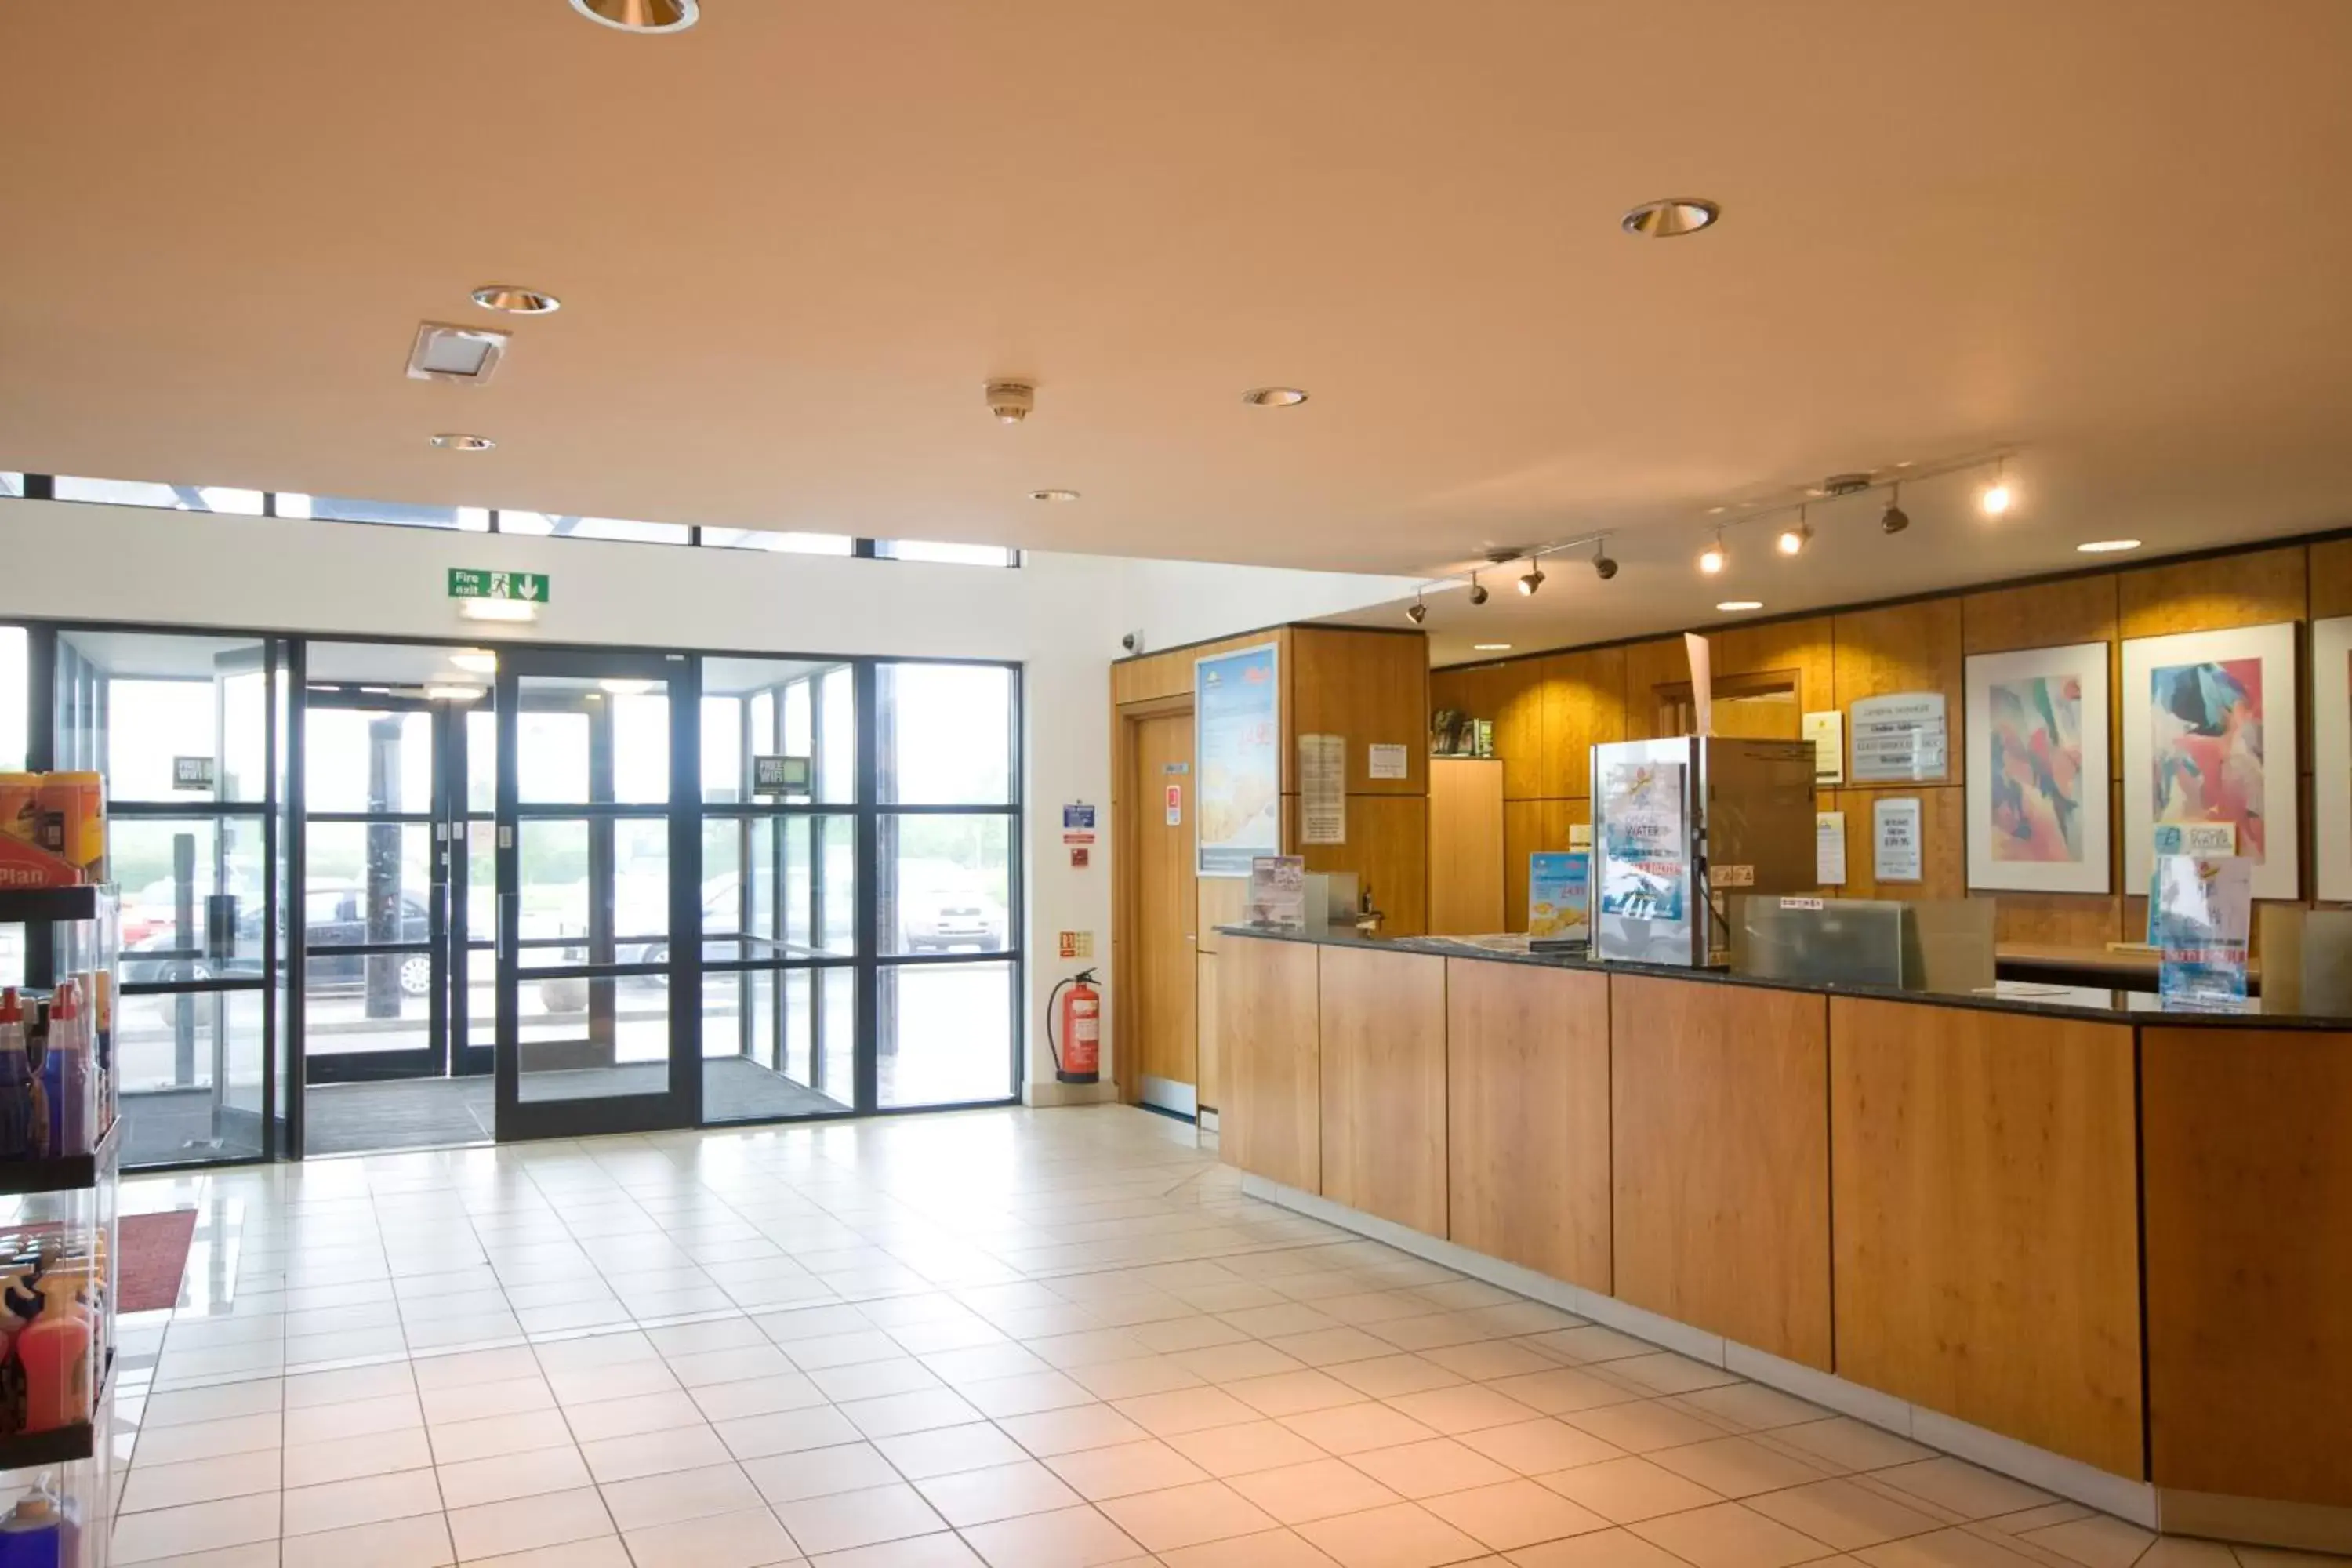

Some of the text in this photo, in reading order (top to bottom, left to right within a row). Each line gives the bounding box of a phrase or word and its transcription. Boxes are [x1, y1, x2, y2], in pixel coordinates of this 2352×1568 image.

[456, 571, 479, 583] Fire
[456, 585, 477, 595] exit
[0, 868, 43, 885] Plan
